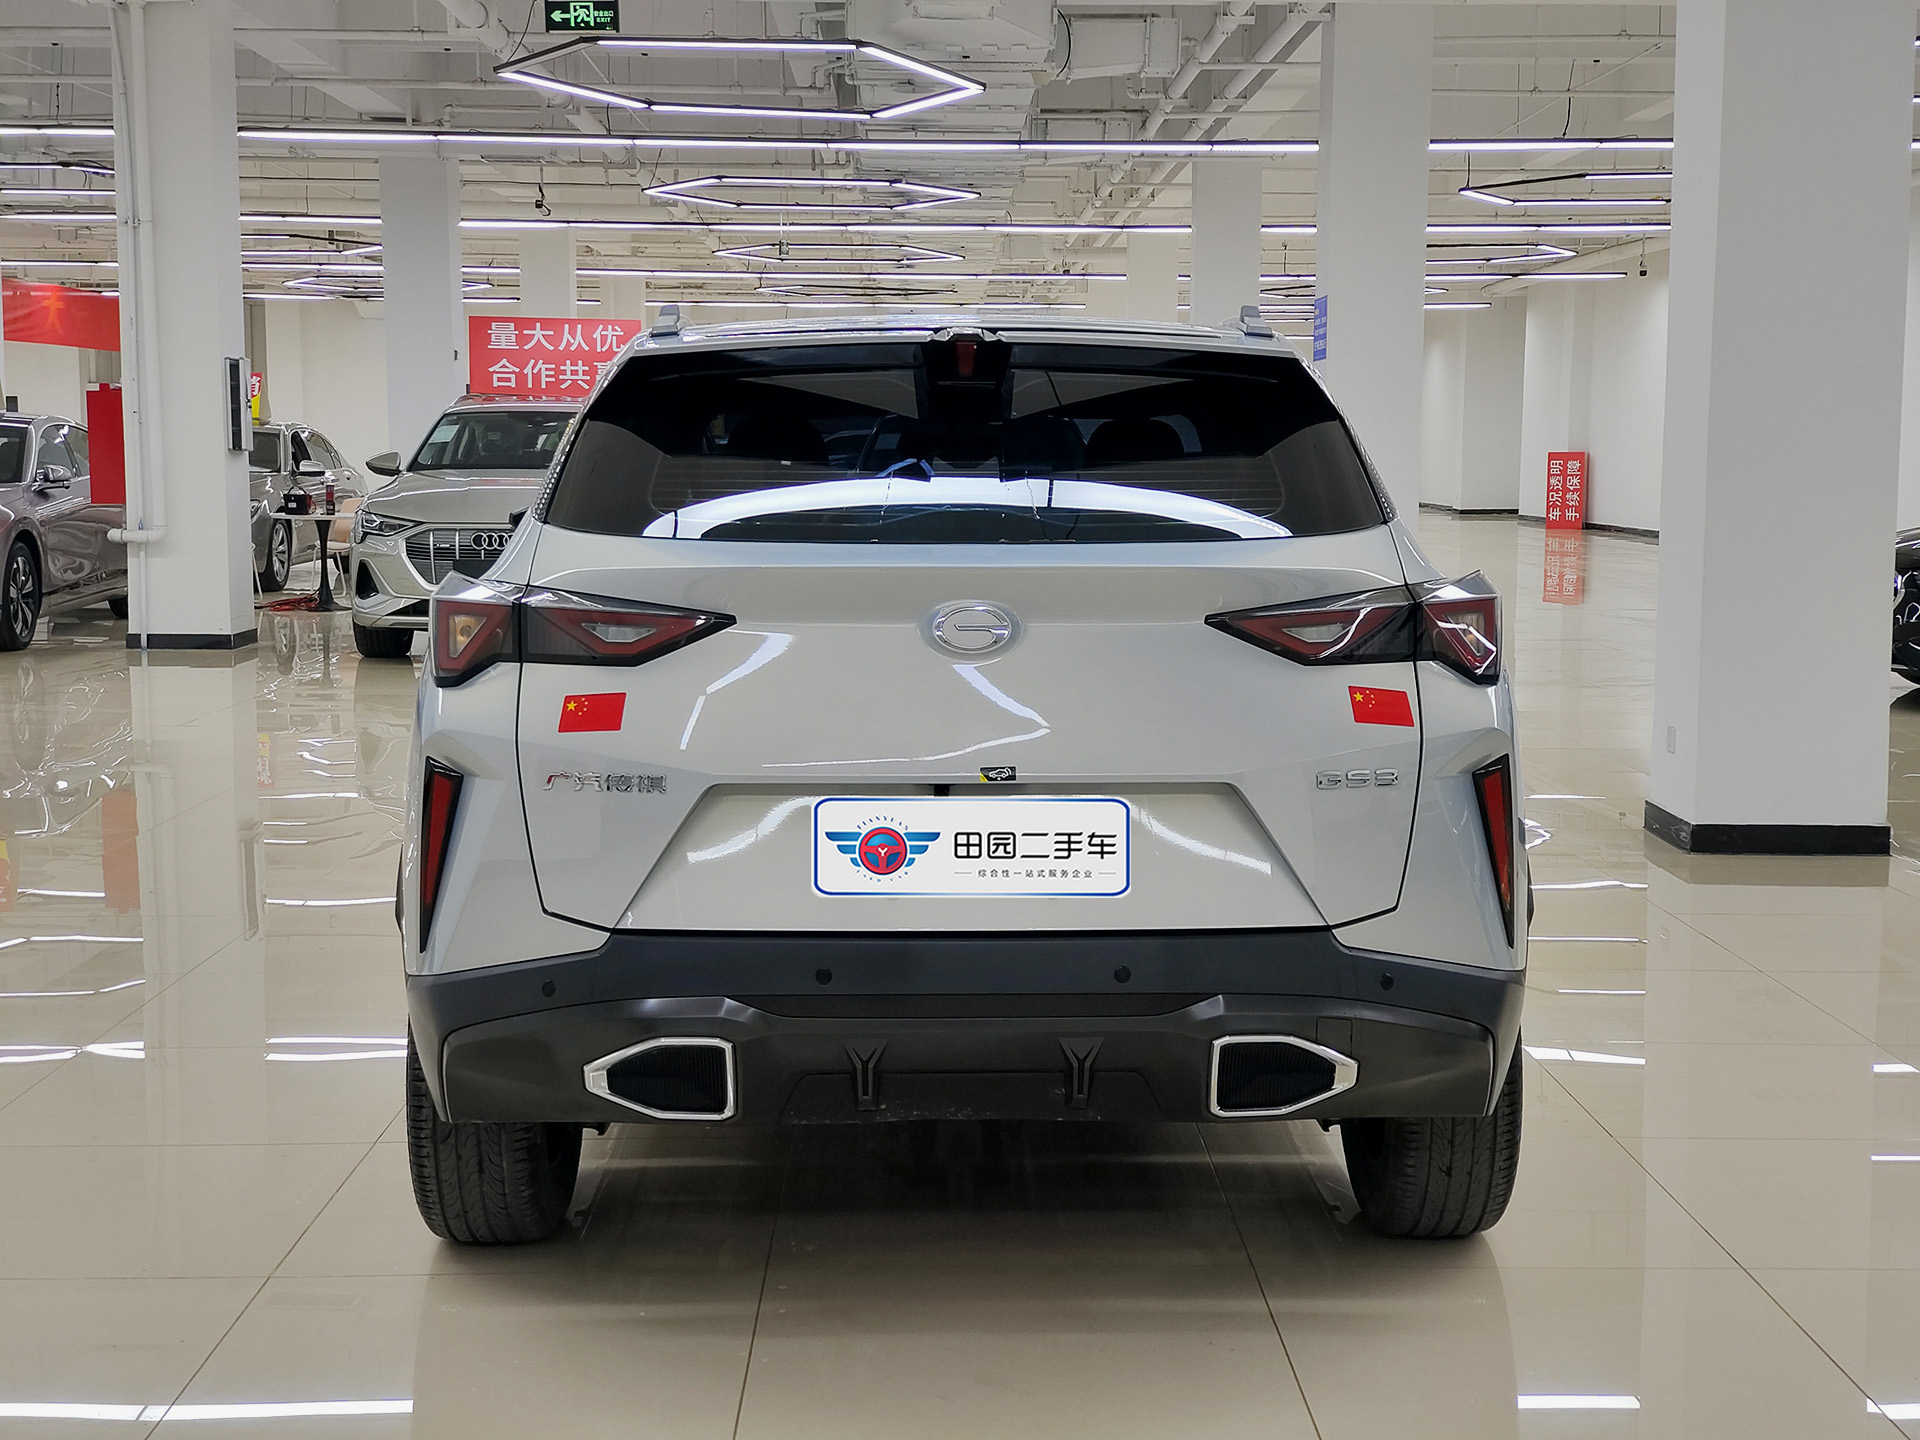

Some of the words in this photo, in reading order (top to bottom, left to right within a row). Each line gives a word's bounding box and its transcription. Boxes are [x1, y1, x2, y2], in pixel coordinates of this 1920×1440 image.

[487, 321, 625, 353] 量大从优
[1548, 460, 1564, 521] 车况透明
[1565, 459, 1582, 522] 手续保障
[1316, 768, 1399, 789] GS3
